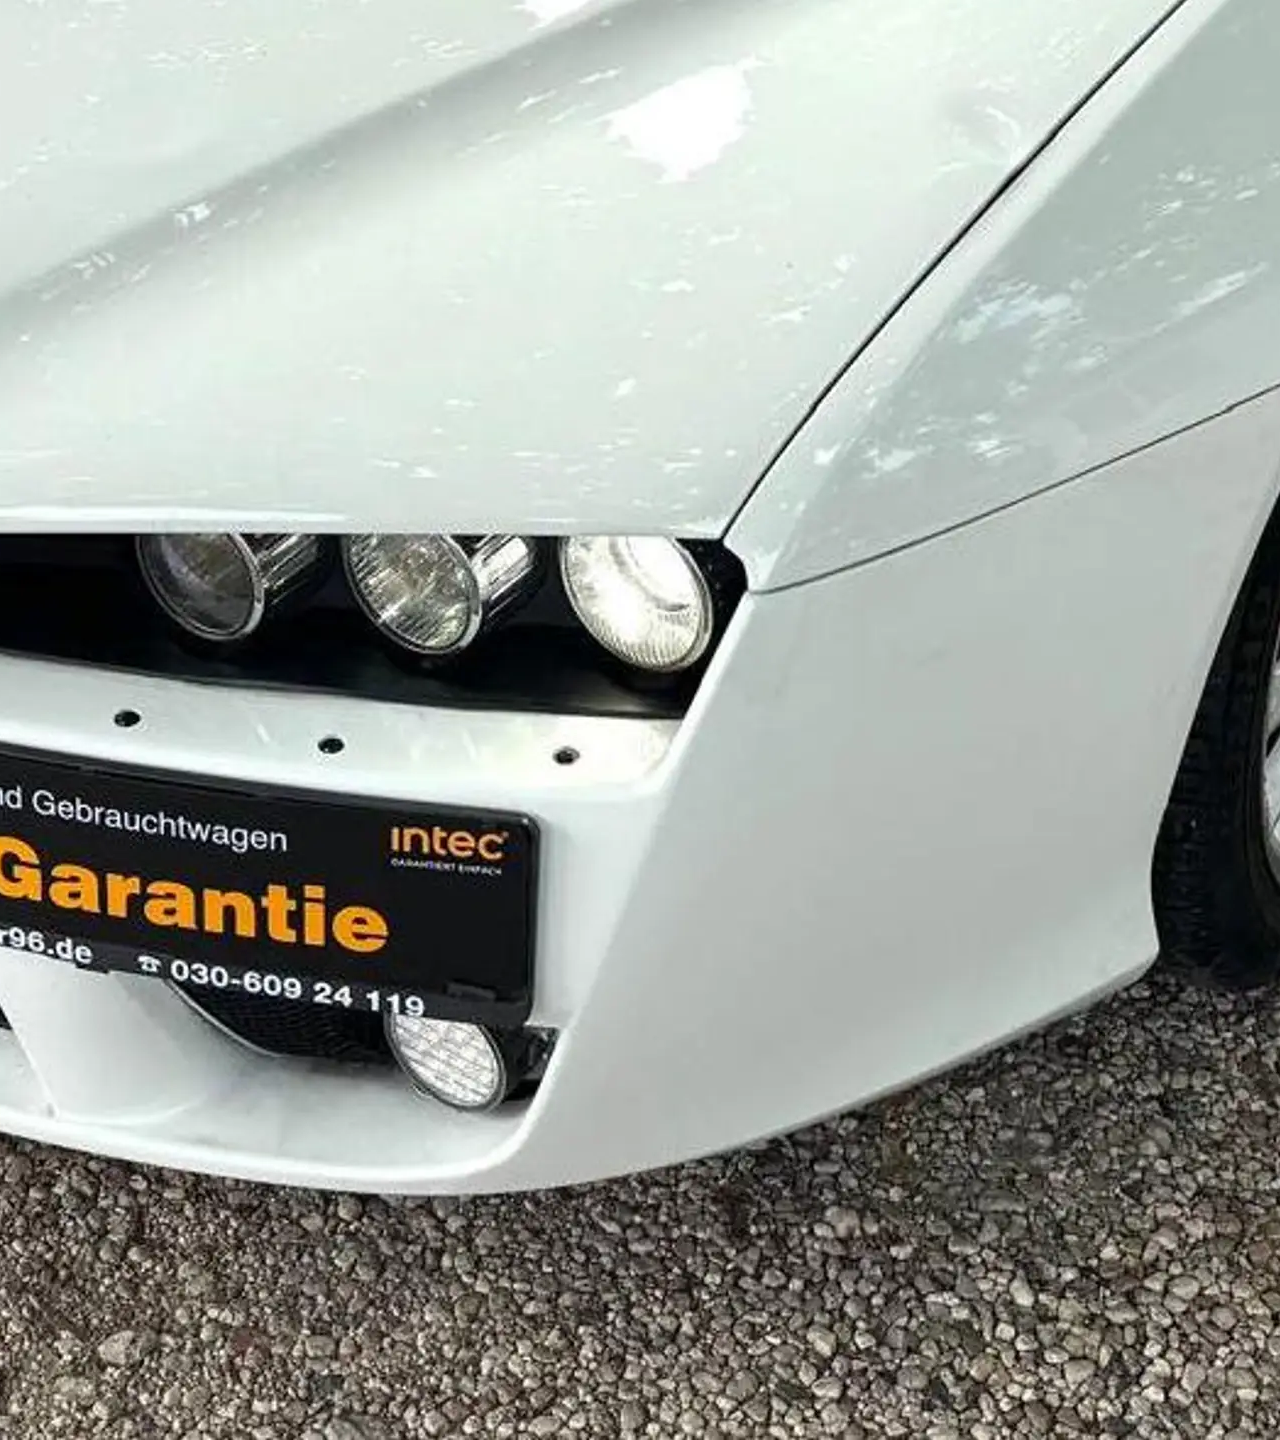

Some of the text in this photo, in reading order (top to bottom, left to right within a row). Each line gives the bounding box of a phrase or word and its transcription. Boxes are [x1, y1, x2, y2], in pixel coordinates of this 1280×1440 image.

[31, 789, 288, 853] Gebrauchtwagen
[169, 958, 303, 1000] 030-609
[312, 981, 354, 1009] 24
[365, 990, 425, 1018] 119
